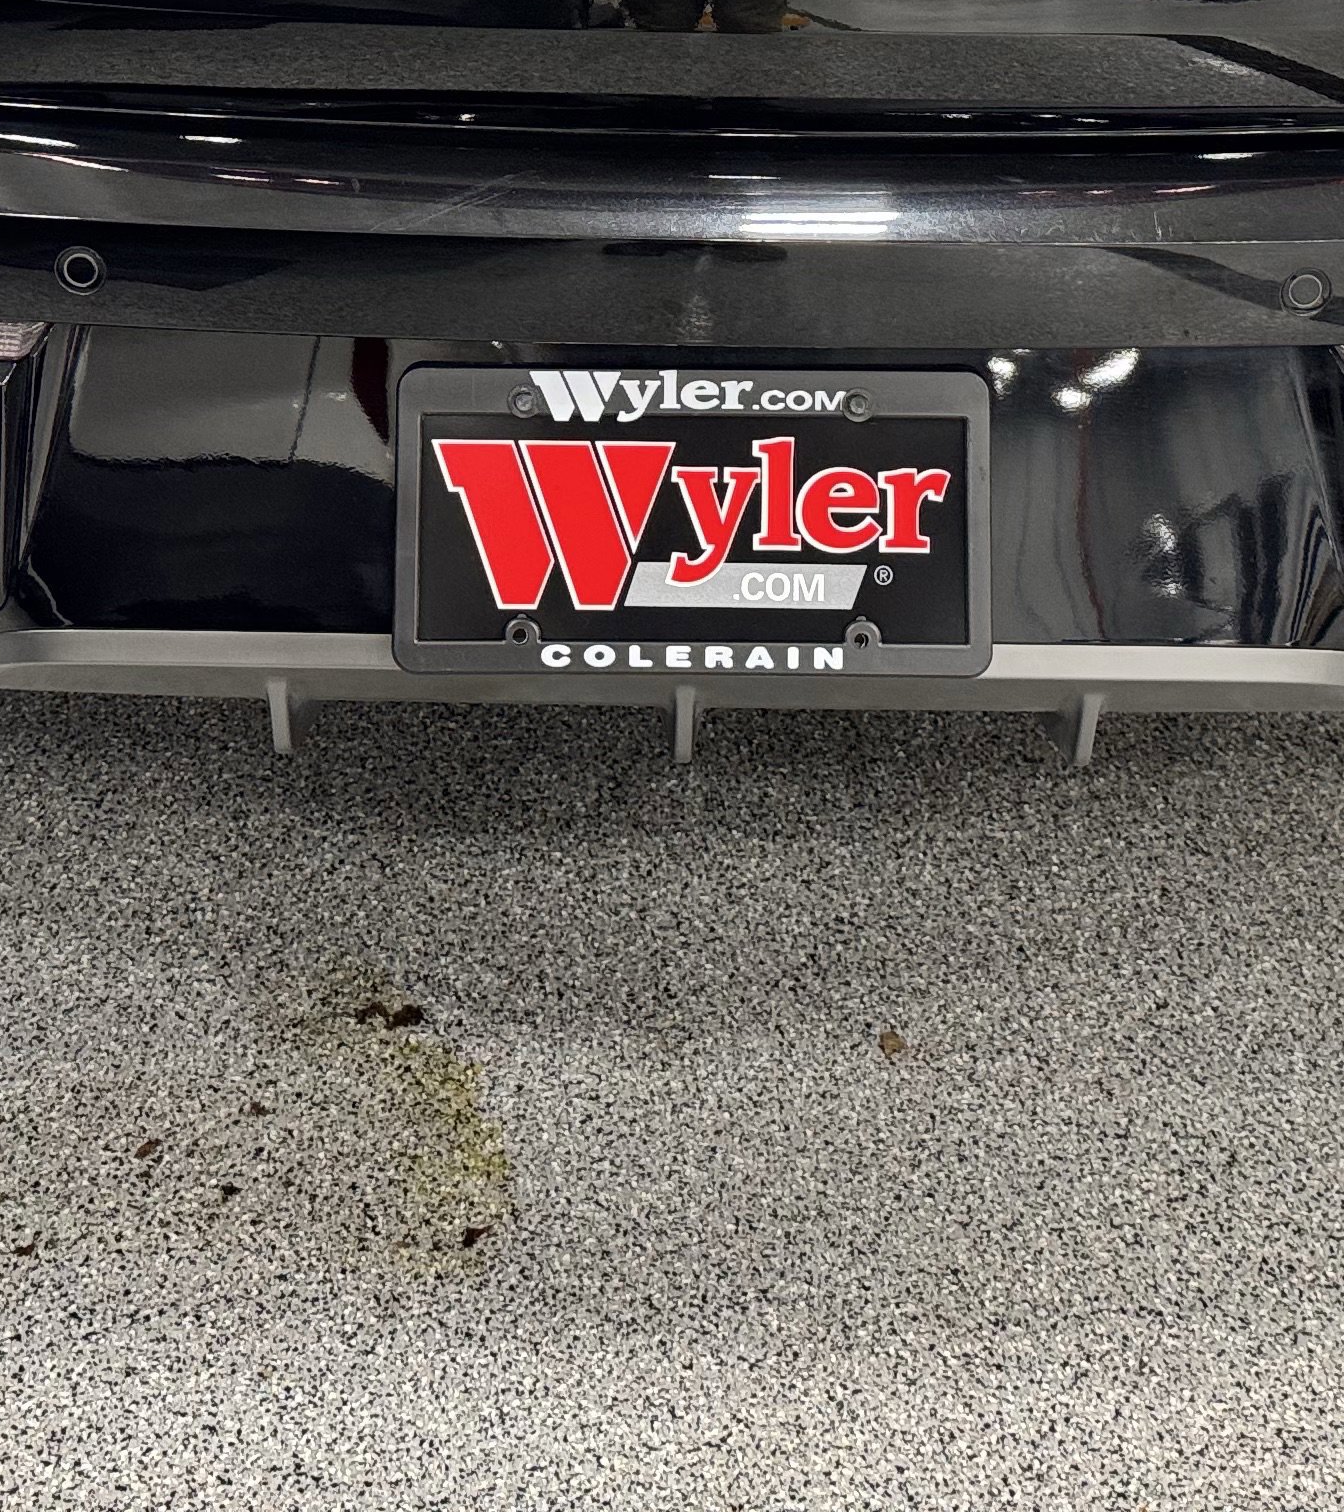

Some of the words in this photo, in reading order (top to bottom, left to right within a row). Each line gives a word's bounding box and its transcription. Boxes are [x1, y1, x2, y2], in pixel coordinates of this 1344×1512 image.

[431, 436, 951, 611] Wyler
[733, 571, 826, 602] .COM
[540, 643, 844, 670] COLERAIN
